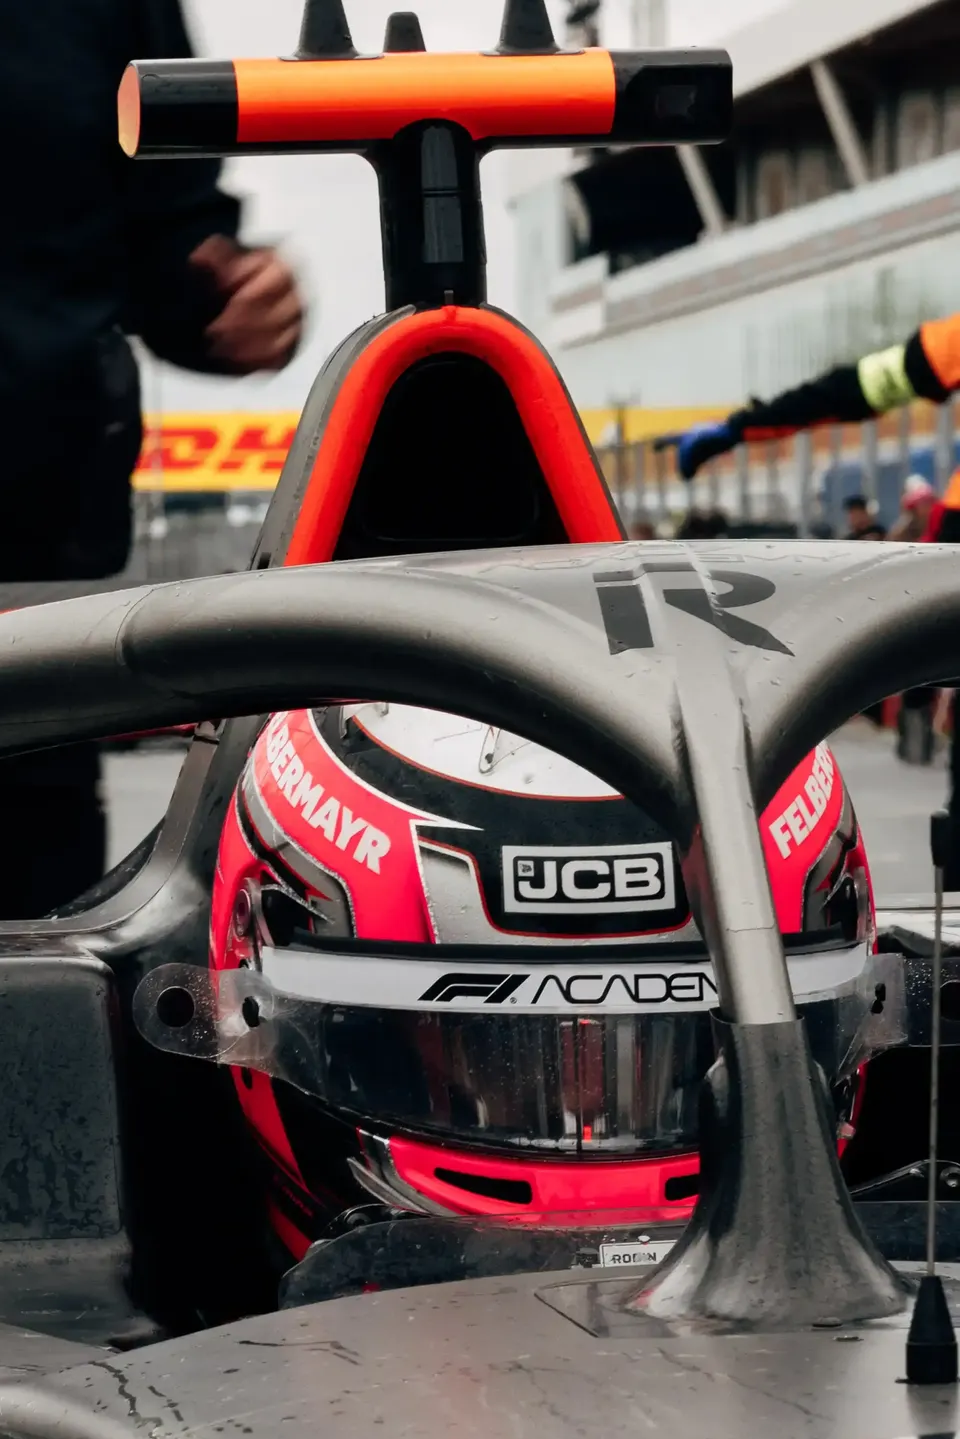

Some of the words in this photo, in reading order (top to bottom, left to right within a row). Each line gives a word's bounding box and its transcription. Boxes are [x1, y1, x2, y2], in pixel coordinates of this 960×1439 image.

[136, 425, 299, 474] DH
[768, 739, 834, 860] FELBER
[517, 857, 662, 900] JCB
[417, 972, 532, 1004] F1
[611, 1252, 657, 1264] RON
